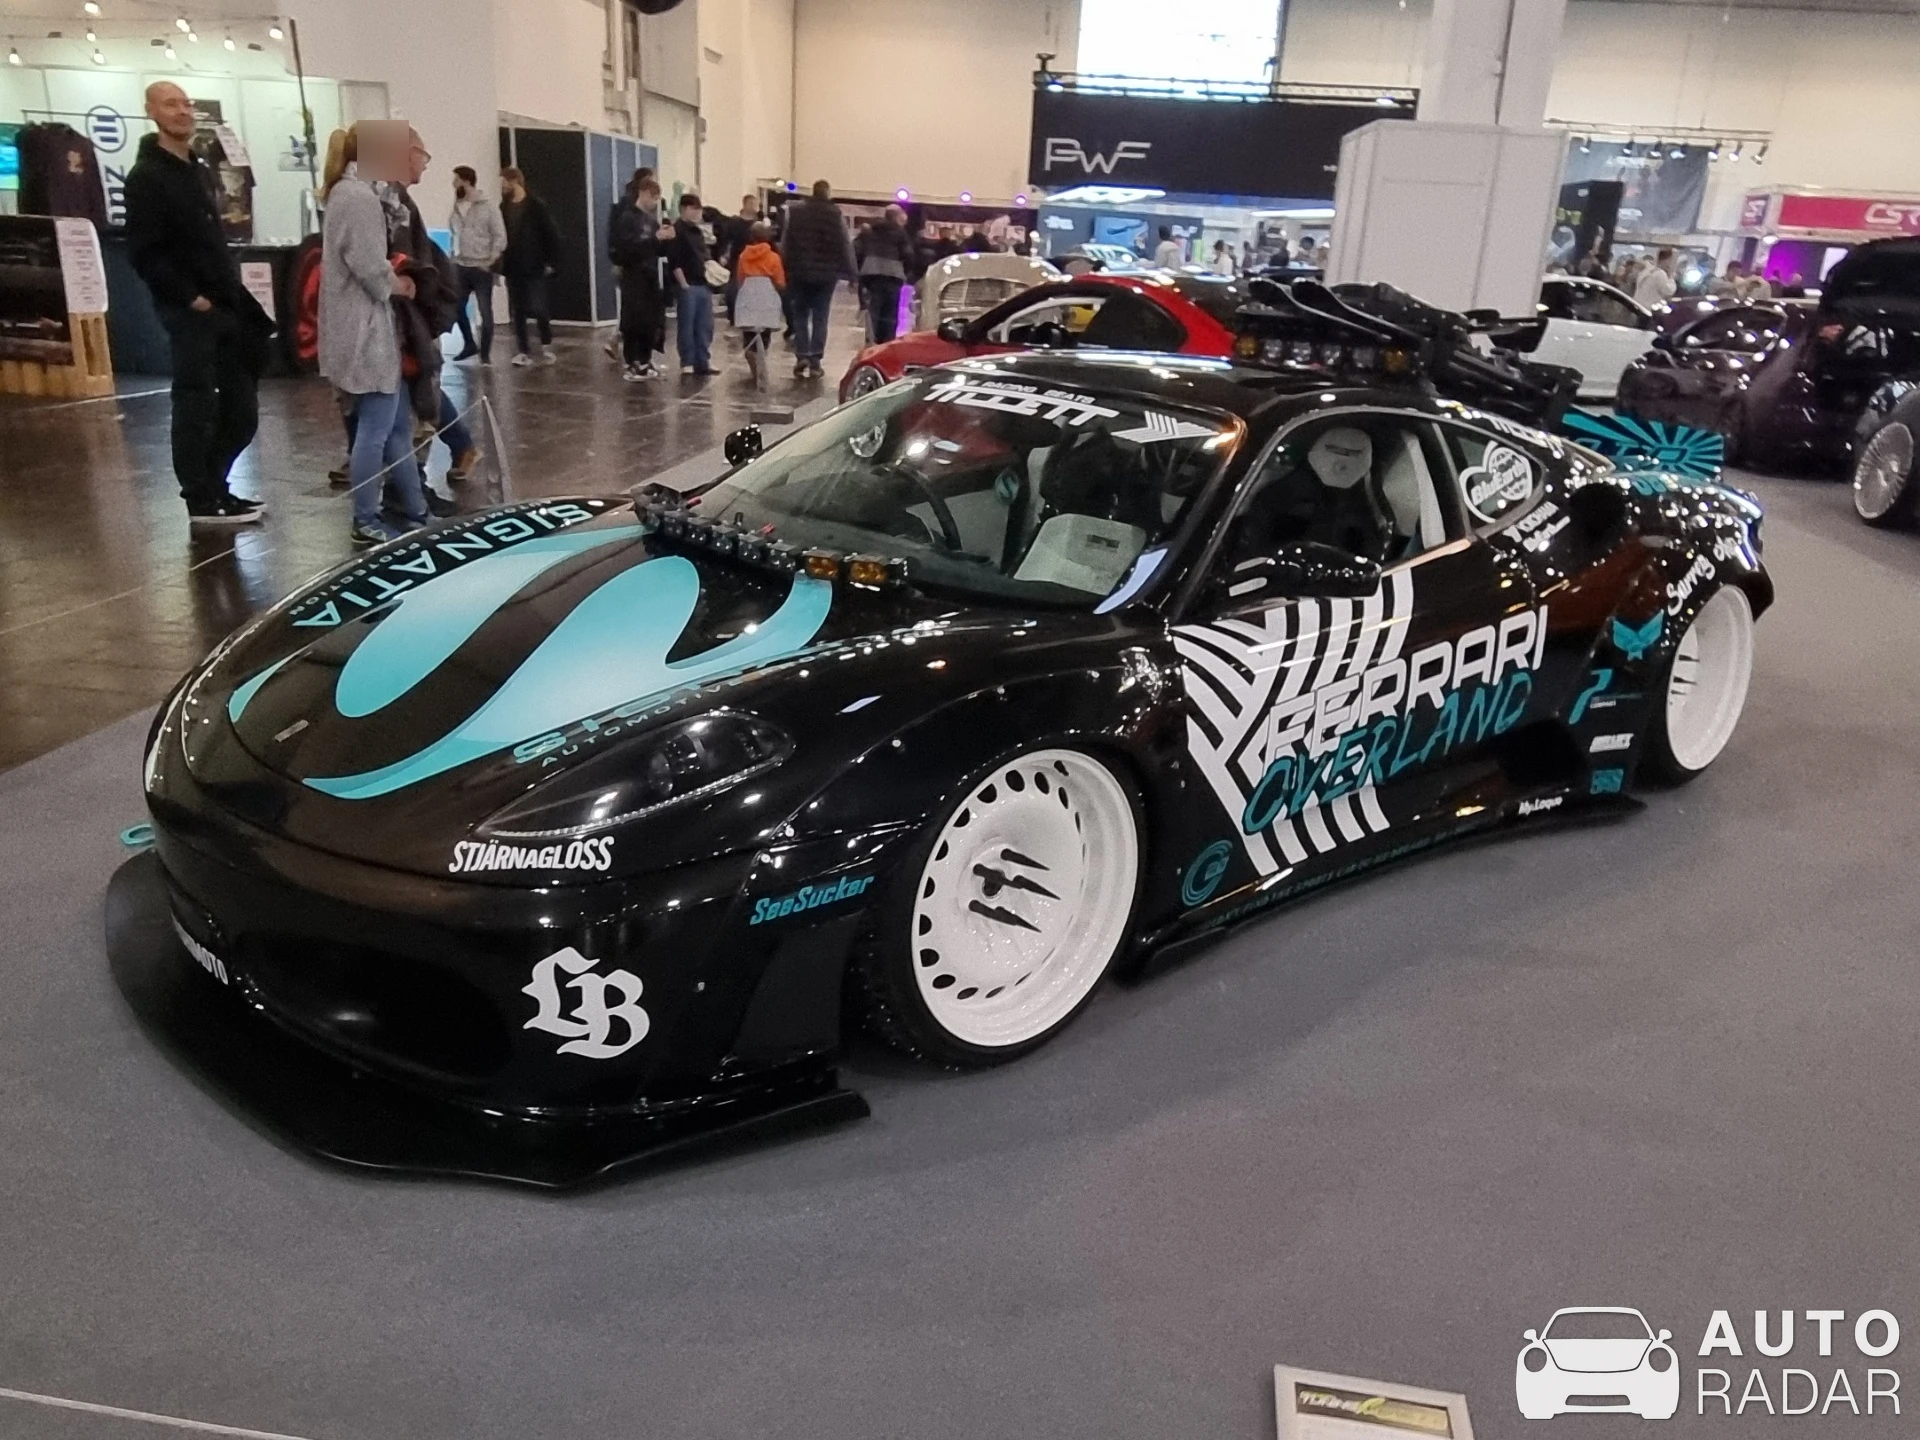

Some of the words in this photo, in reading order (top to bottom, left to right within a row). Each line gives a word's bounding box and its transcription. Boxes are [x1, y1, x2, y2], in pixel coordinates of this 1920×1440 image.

[1044, 138, 1152, 174] PWF
[292, 503, 594, 627] SIGNATIA
[1262, 604, 1548, 772] FERRARI
[1244, 671, 1532, 833] OVERLAND
[449, 836, 614, 873] STJÄRNAGLOSS
[750, 876, 875, 925] SeeSucker
